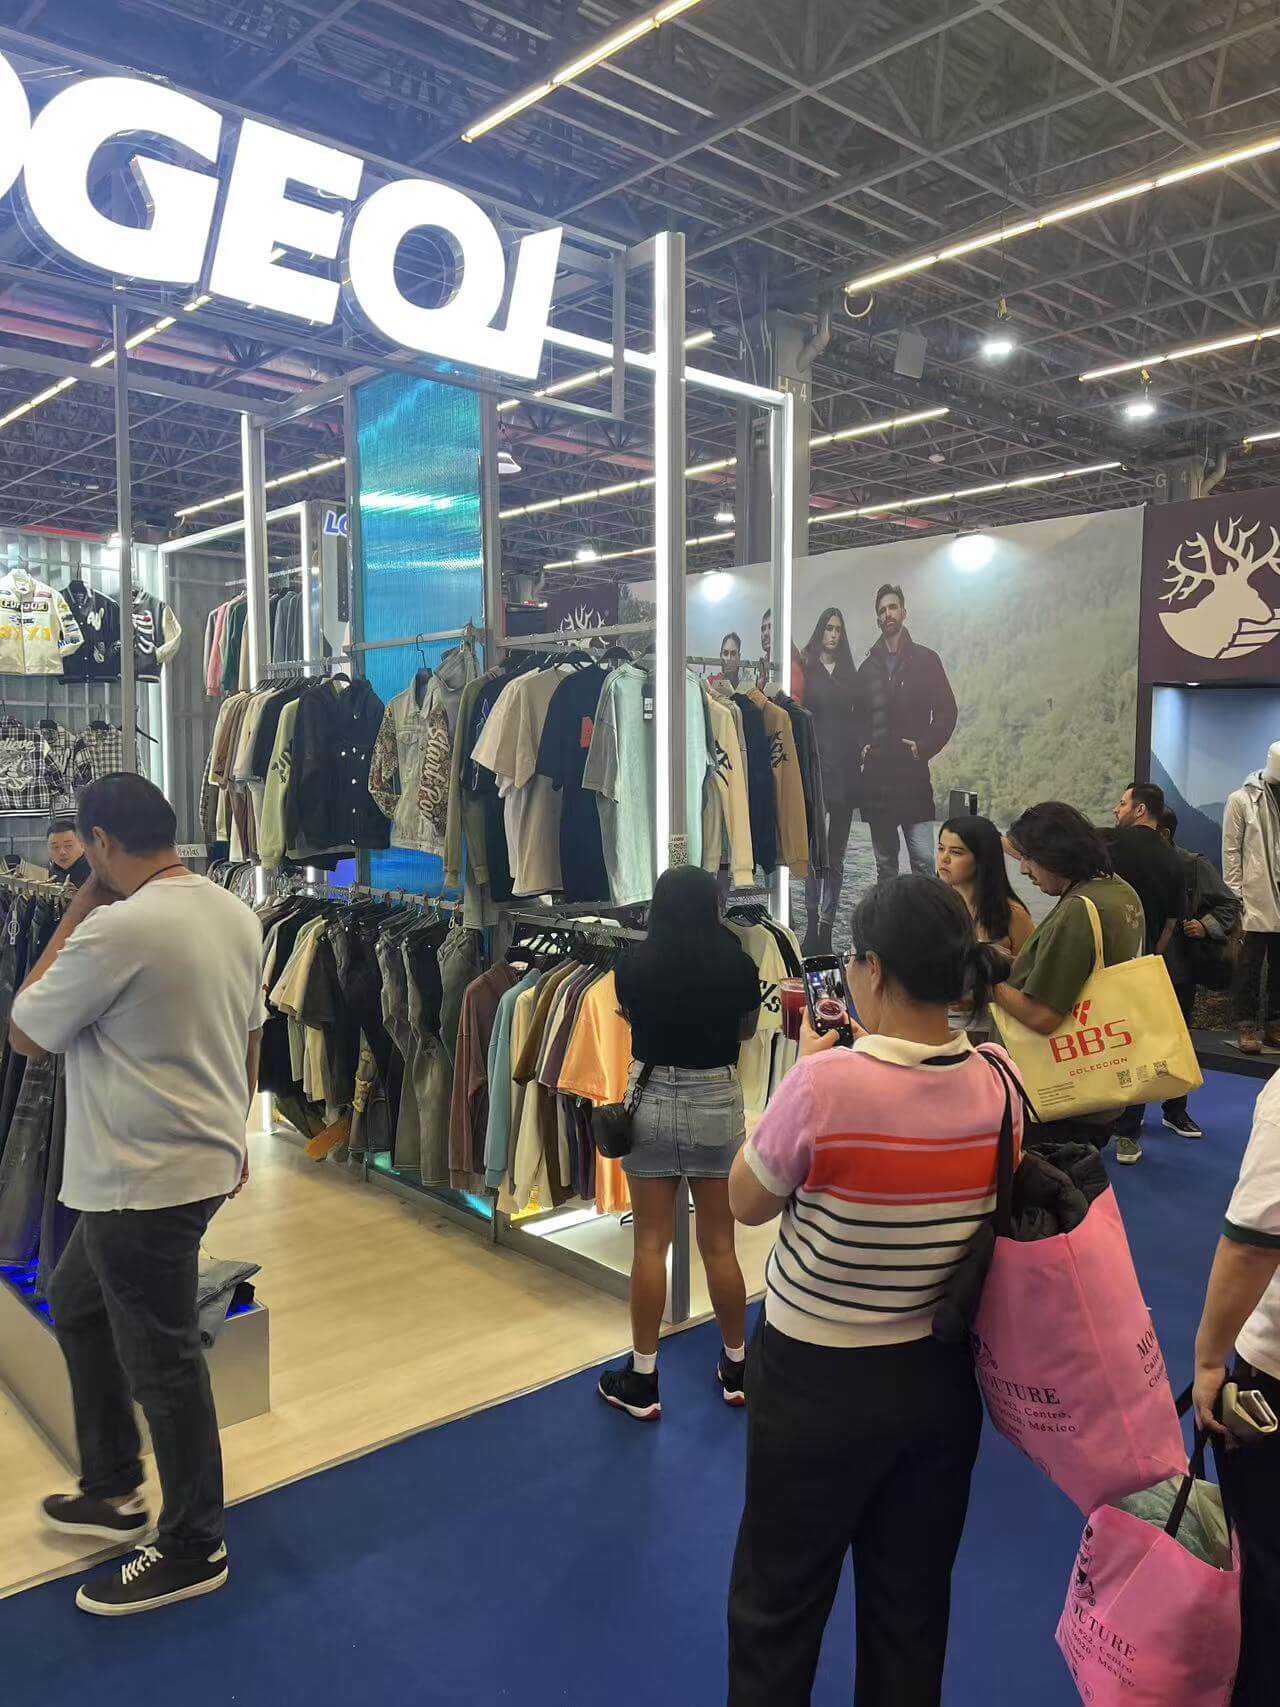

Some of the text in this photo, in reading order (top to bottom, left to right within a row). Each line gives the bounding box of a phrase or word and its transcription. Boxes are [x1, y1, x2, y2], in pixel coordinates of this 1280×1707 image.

[0, 50, 562, 379] GEQI
[1049, 1019, 1133, 1063] BBS
[1069, 1057, 1128, 1076] COLECCION
